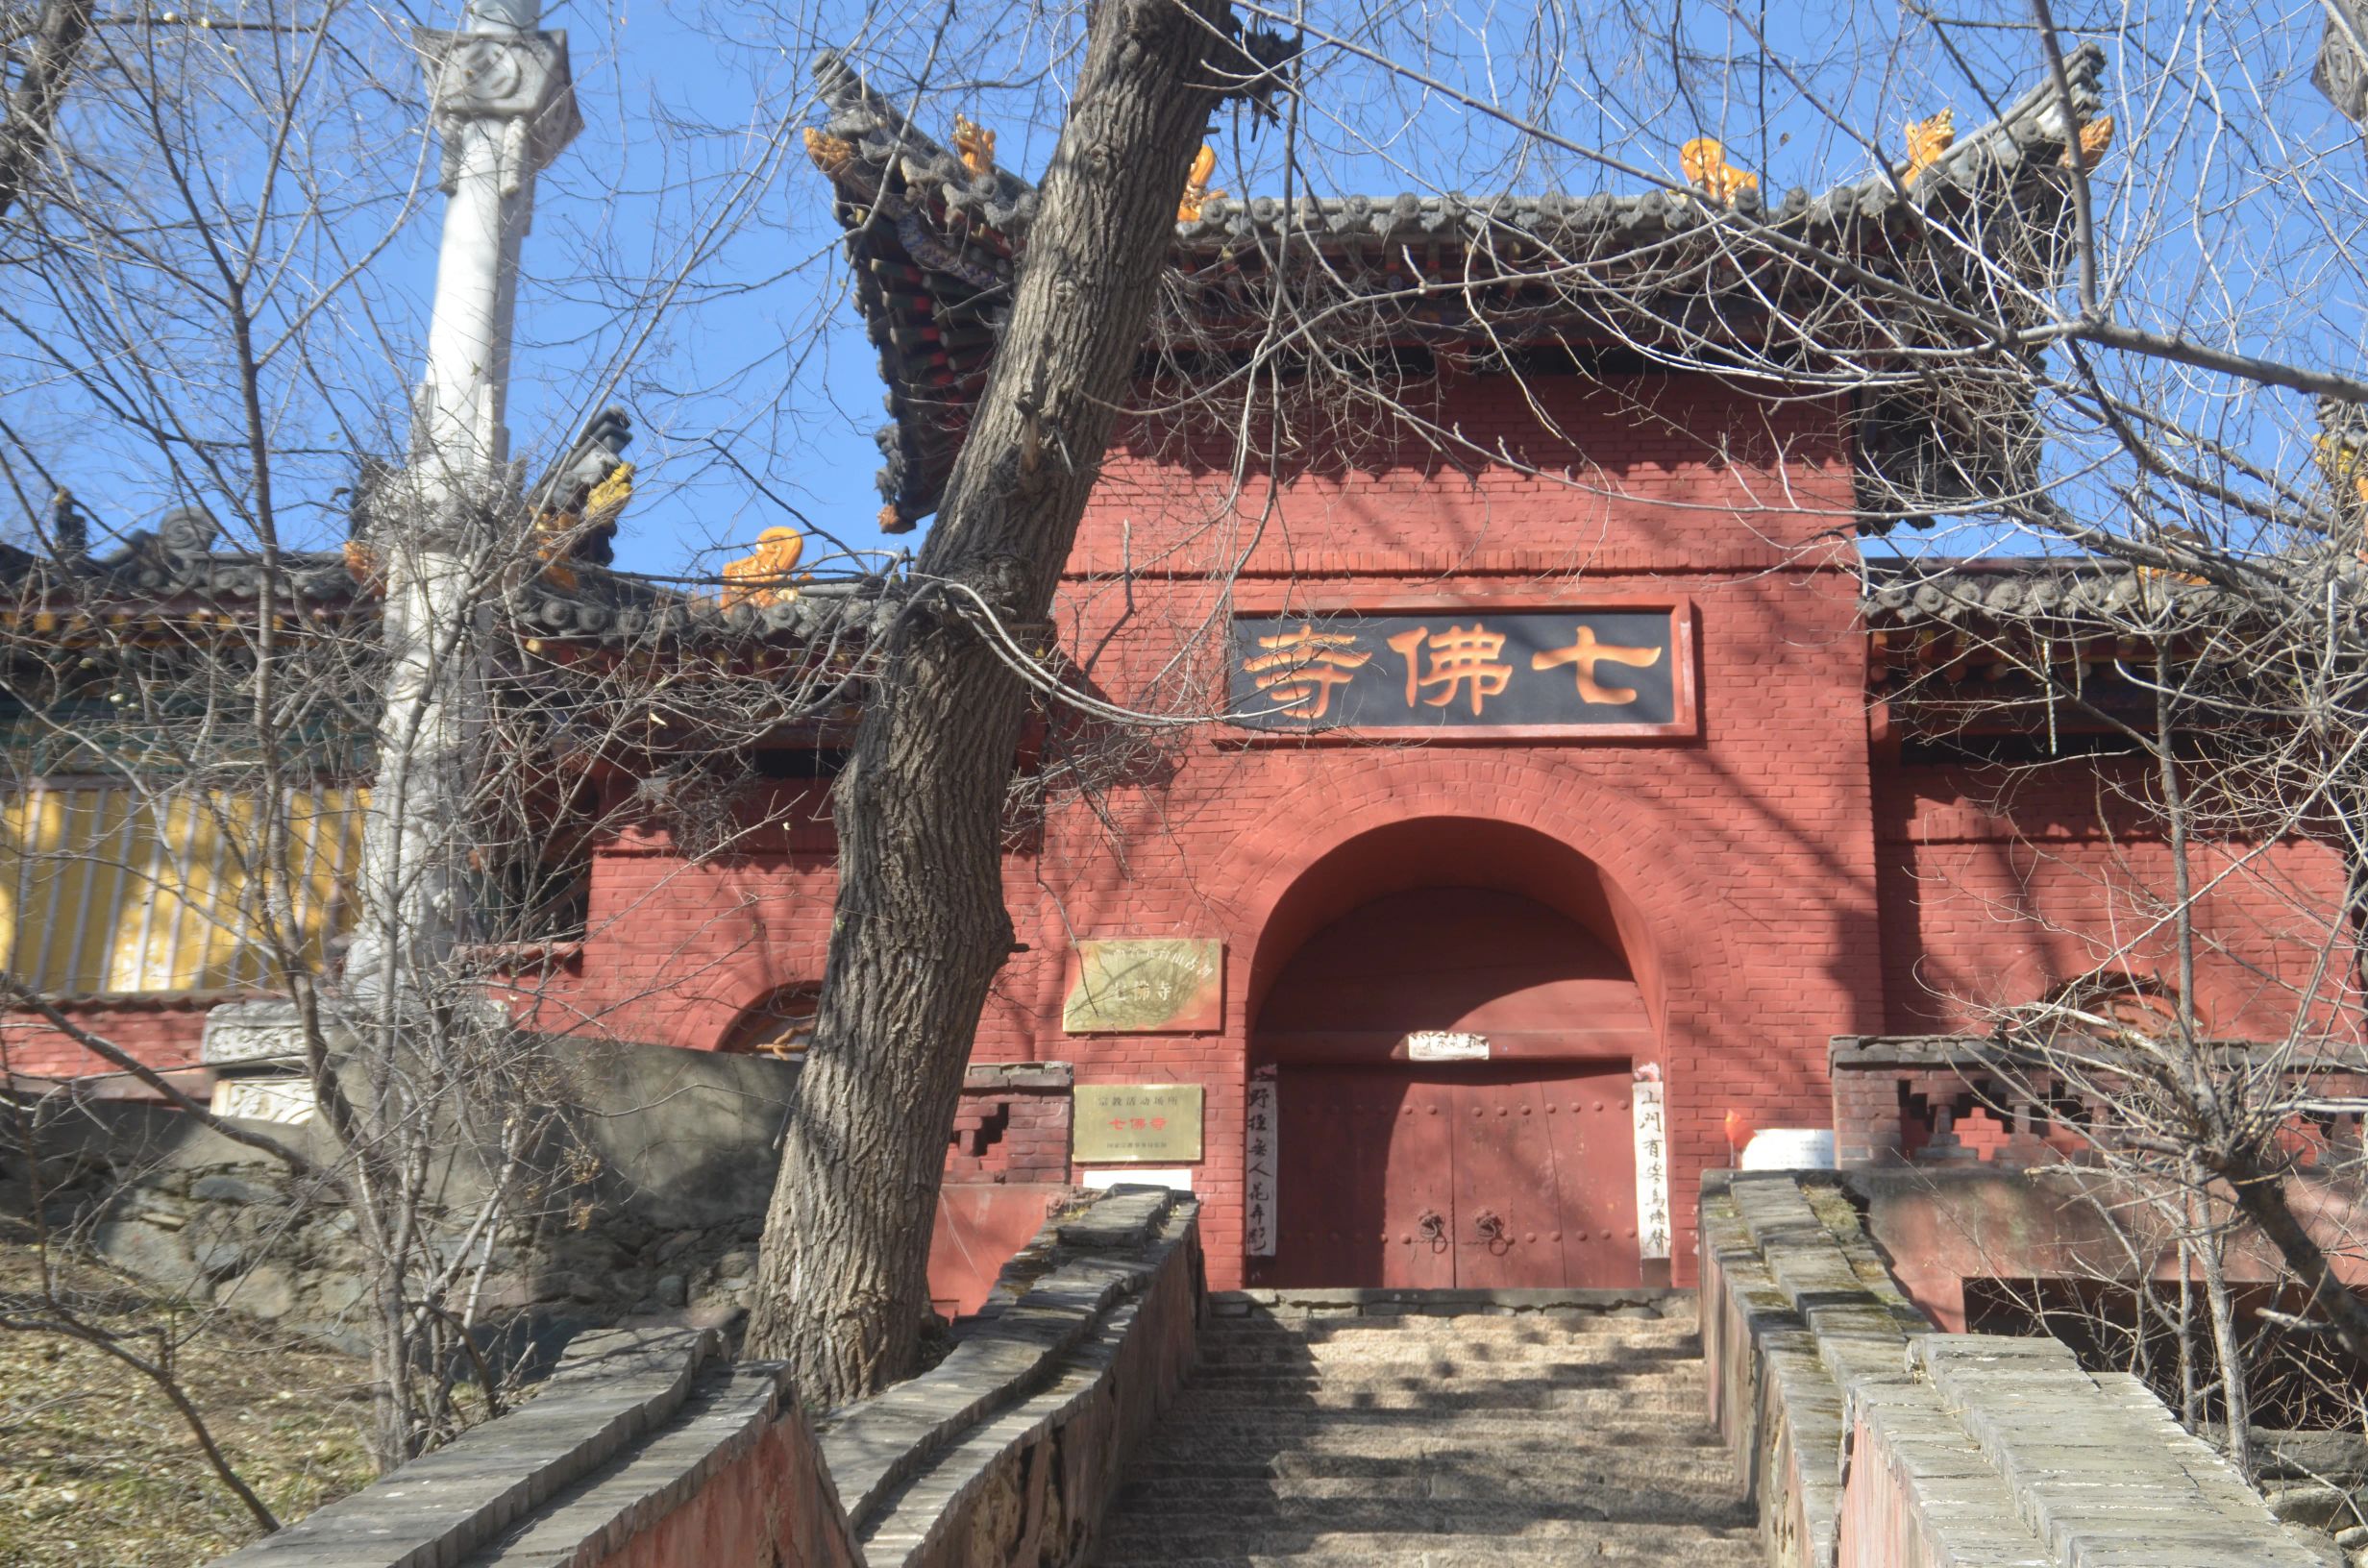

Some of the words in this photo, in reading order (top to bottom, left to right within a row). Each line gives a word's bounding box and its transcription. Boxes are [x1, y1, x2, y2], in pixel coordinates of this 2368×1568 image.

[1243, 623, 1663, 719] 七佛寺
[1106, 1115, 1170, 1131] 七佛寺
